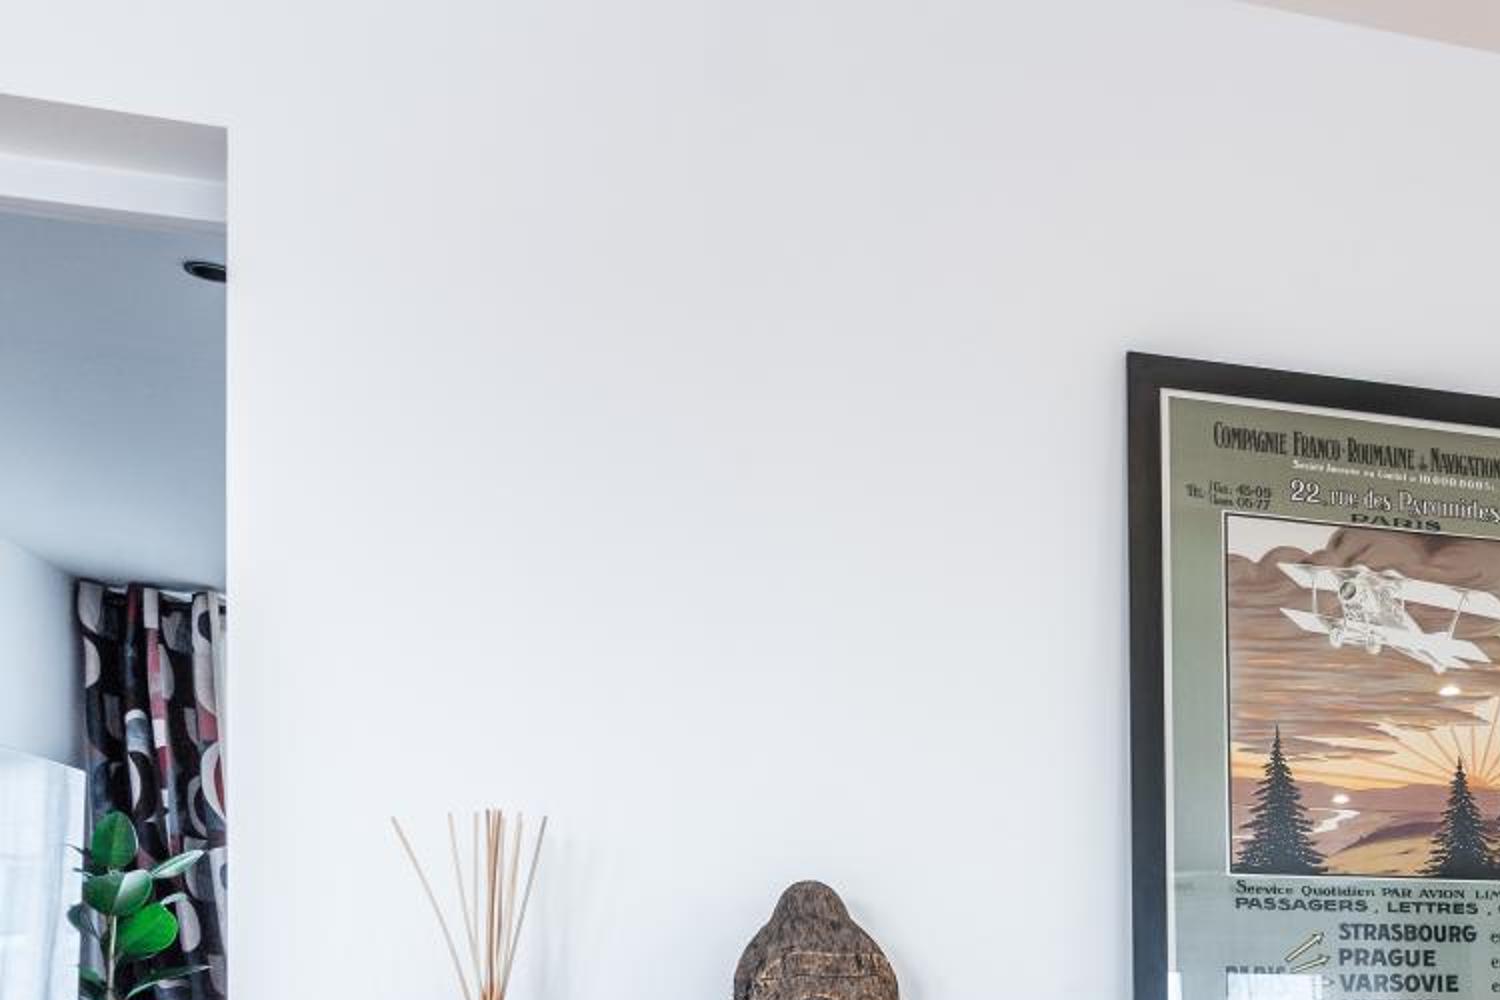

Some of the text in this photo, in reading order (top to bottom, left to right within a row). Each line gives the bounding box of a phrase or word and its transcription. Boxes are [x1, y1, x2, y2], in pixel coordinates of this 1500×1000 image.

[1364, 489, 1392, 511] des
[1351, 514, 1441, 532] PARIS
[1236, 880, 1293, 896] Service
[1301, 885, 1375, 898] Quotidien
[1382, 887, 1412, 898] PAR
[1419, 889, 1465, 900] AVION
[1338, 923, 1478, 943] STRASBOURG
[1338, 948, 1437, 967] PRAGUE
[1339, 974, 1460, 993] VARSOVIE
